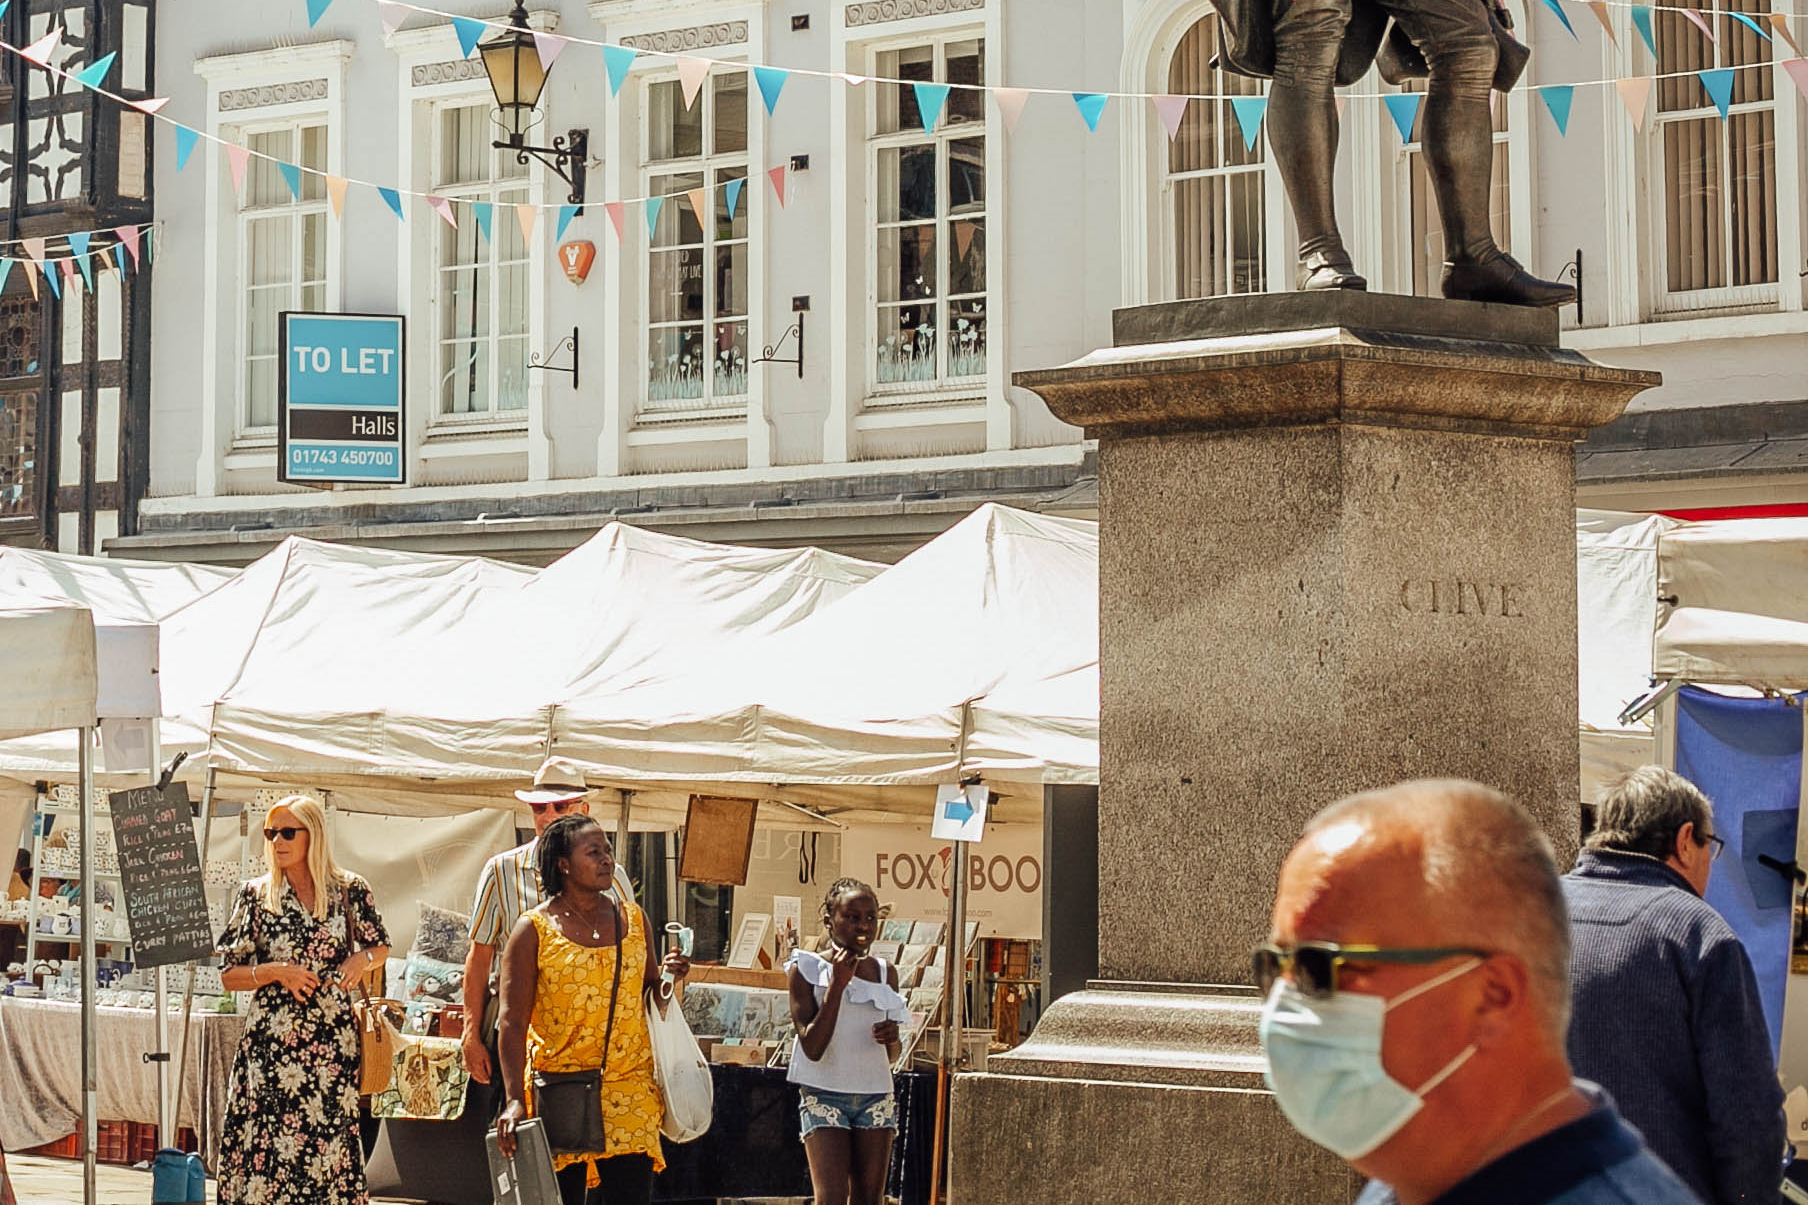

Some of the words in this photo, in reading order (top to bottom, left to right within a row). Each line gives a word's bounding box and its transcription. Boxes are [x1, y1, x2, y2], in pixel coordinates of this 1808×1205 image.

[293, 346, 331, 373] TO
[342, 347, 394, 375] LET
[352, 415, 396, 435] Halls
[293, 449, 337, 465] 01743
[341, 450, 393, 465] 450700
[1400, 579, 1524, 617] CLIVE
[153, 808, 176, 824] GOAT
[148, 847, 184, 864] CHICKEN
[876, 853, 936, 890] FOX
[970, 855, 1041, 893] BOO
[130, 892, 159, 907] SOUTH
[163, 885, 199, 900] AFRICAN
[130, 903, 169, 918] CHICKEN
[174, 896, 203, 911] CURRY
[135, 936, 166, 952] CURRY
